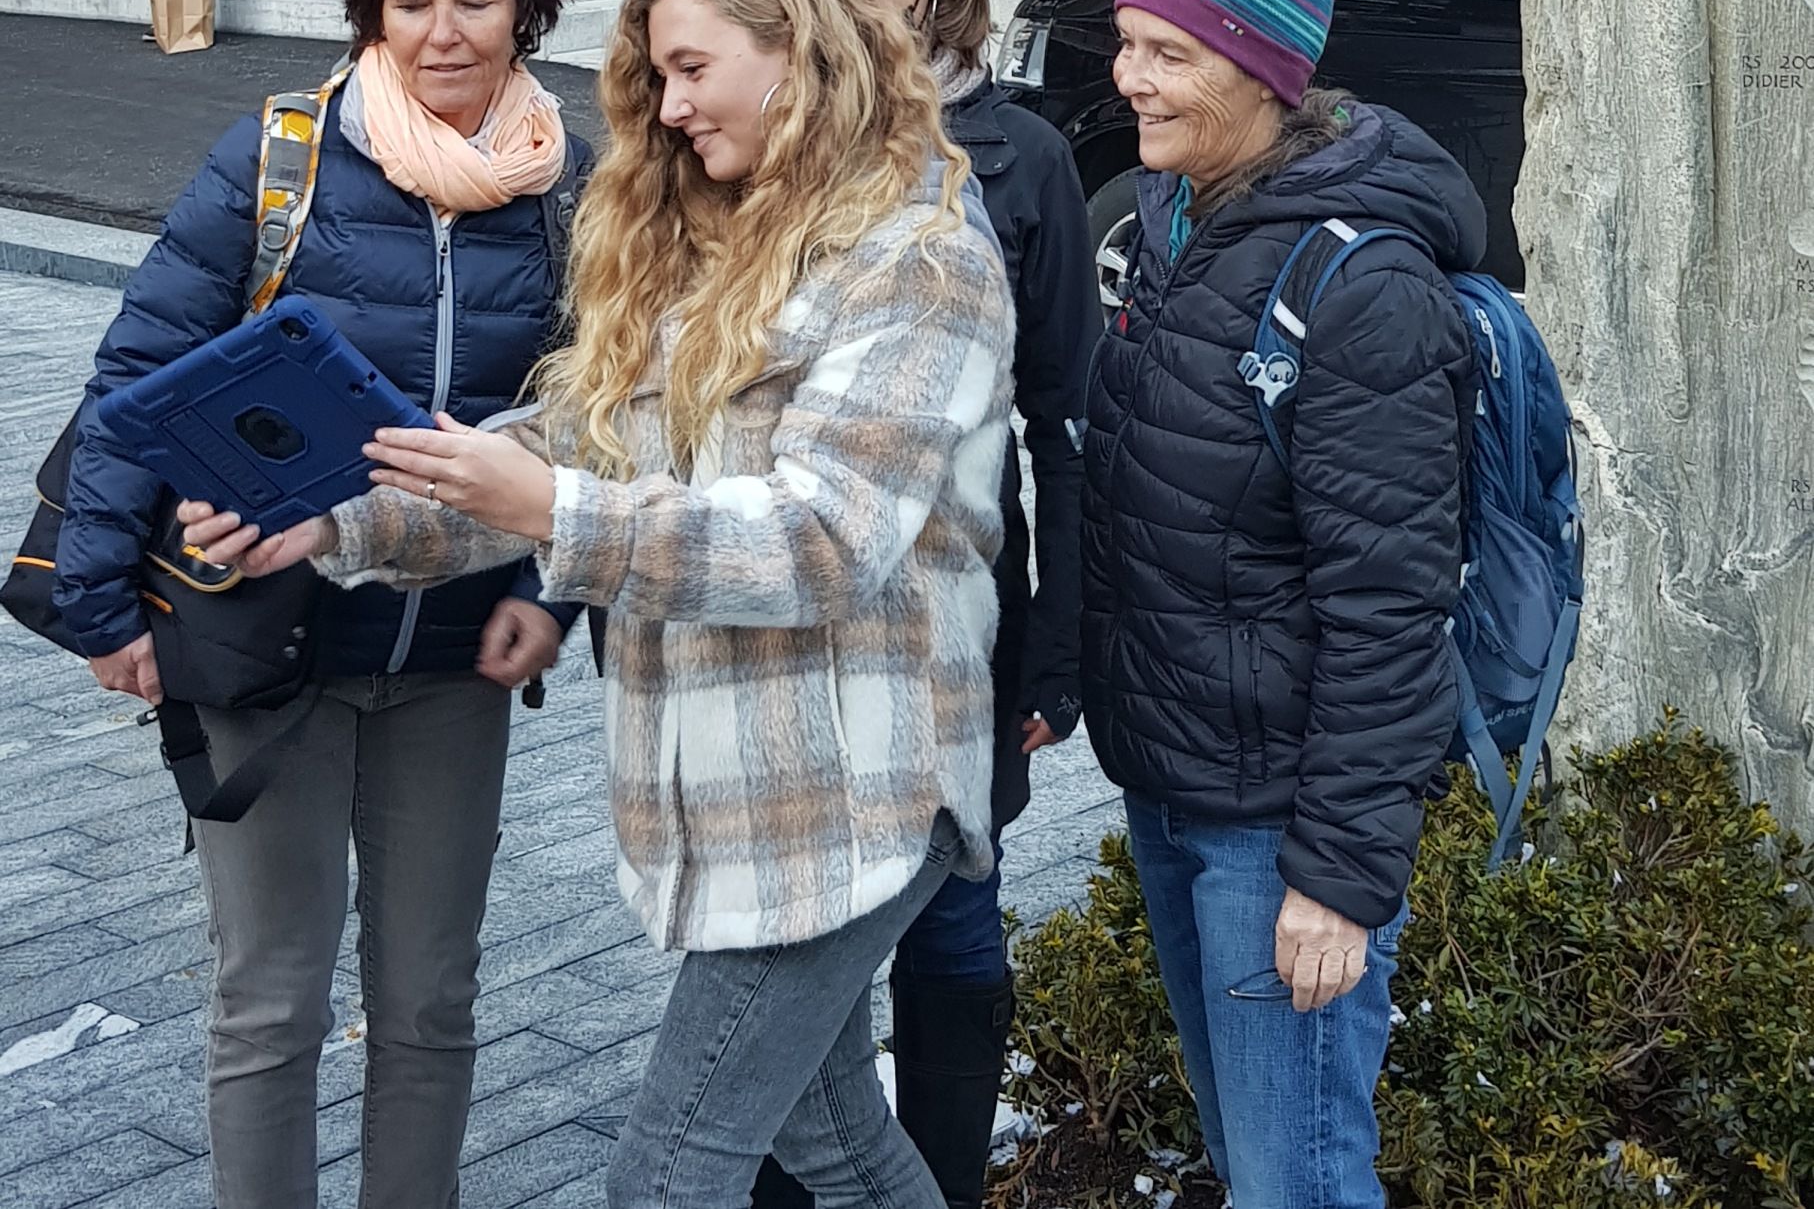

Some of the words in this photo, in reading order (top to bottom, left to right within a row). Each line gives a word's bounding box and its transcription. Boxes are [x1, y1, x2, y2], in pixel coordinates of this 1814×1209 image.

[1742, 55, 1761, 70] RS
[1743, 74, 1804, 89] DIDIER
[1790, 479, 1811, 493] RS
